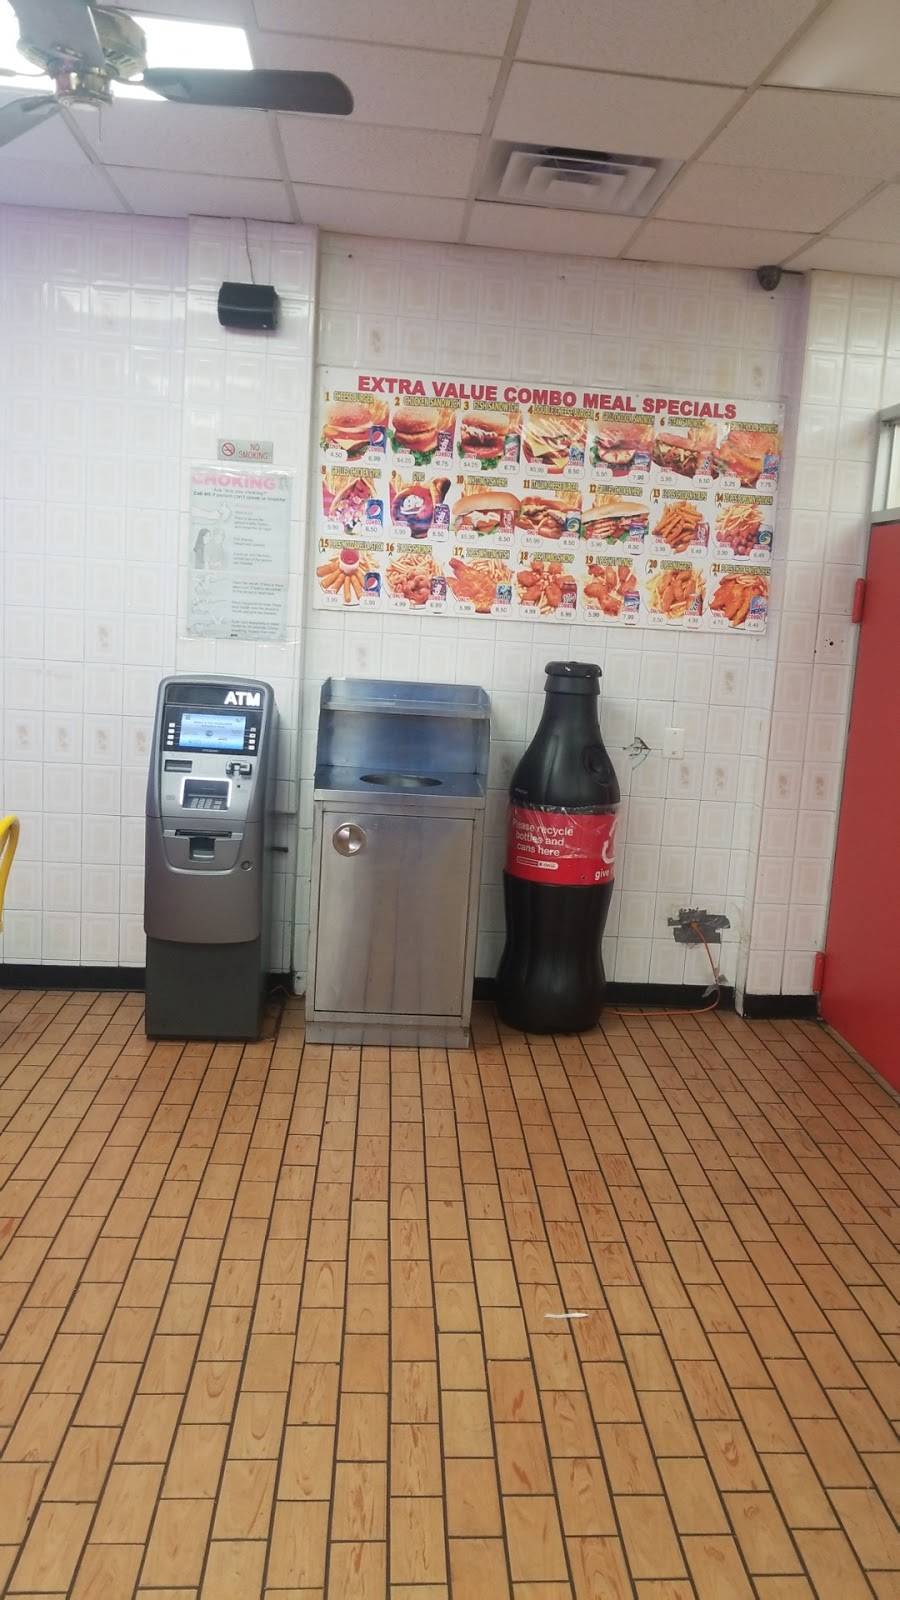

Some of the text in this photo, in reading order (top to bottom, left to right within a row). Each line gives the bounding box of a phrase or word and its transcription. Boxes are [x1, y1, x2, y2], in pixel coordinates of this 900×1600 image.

[326, 392, 330, 401] 1
[358, 376, 736, 420] EXTRA VALUE COMBO MEAL SPECIALS
[394, 396, 400, 406] 2
[464, 401, 470, 410] 3
[528, 405, 533, 414] 4
[594, 412, 600, 422] 5
[660, 417, 665, 426] 6
[250, 442, 261, 450] NO
[322, 465, 326, 474] 8
[392, 470, 397, 479] 9
[456, 475, 464, 484] 10
[523, 480, 530, 489] 11
[590, 484, 597, 493] 12
[652, 488, 660, 498] 13
[716, 494, 724, 502] 14
[320, 539, 328, 548] 15
[386, 543, 394, 552] 16
[454, 547, 462, 556] 17
[521, 552, 528, 561] 18
[586, 556, 594, 564] 19
[650, 560, 657, 569] 20
[712, 564, 720, 573] 21
[224, 690, 260, 706] ATM
[536, 825, 574, 838] recycle
[516, 831, 564, 846] bottles and
[516, 843, 560, 856] cans here
